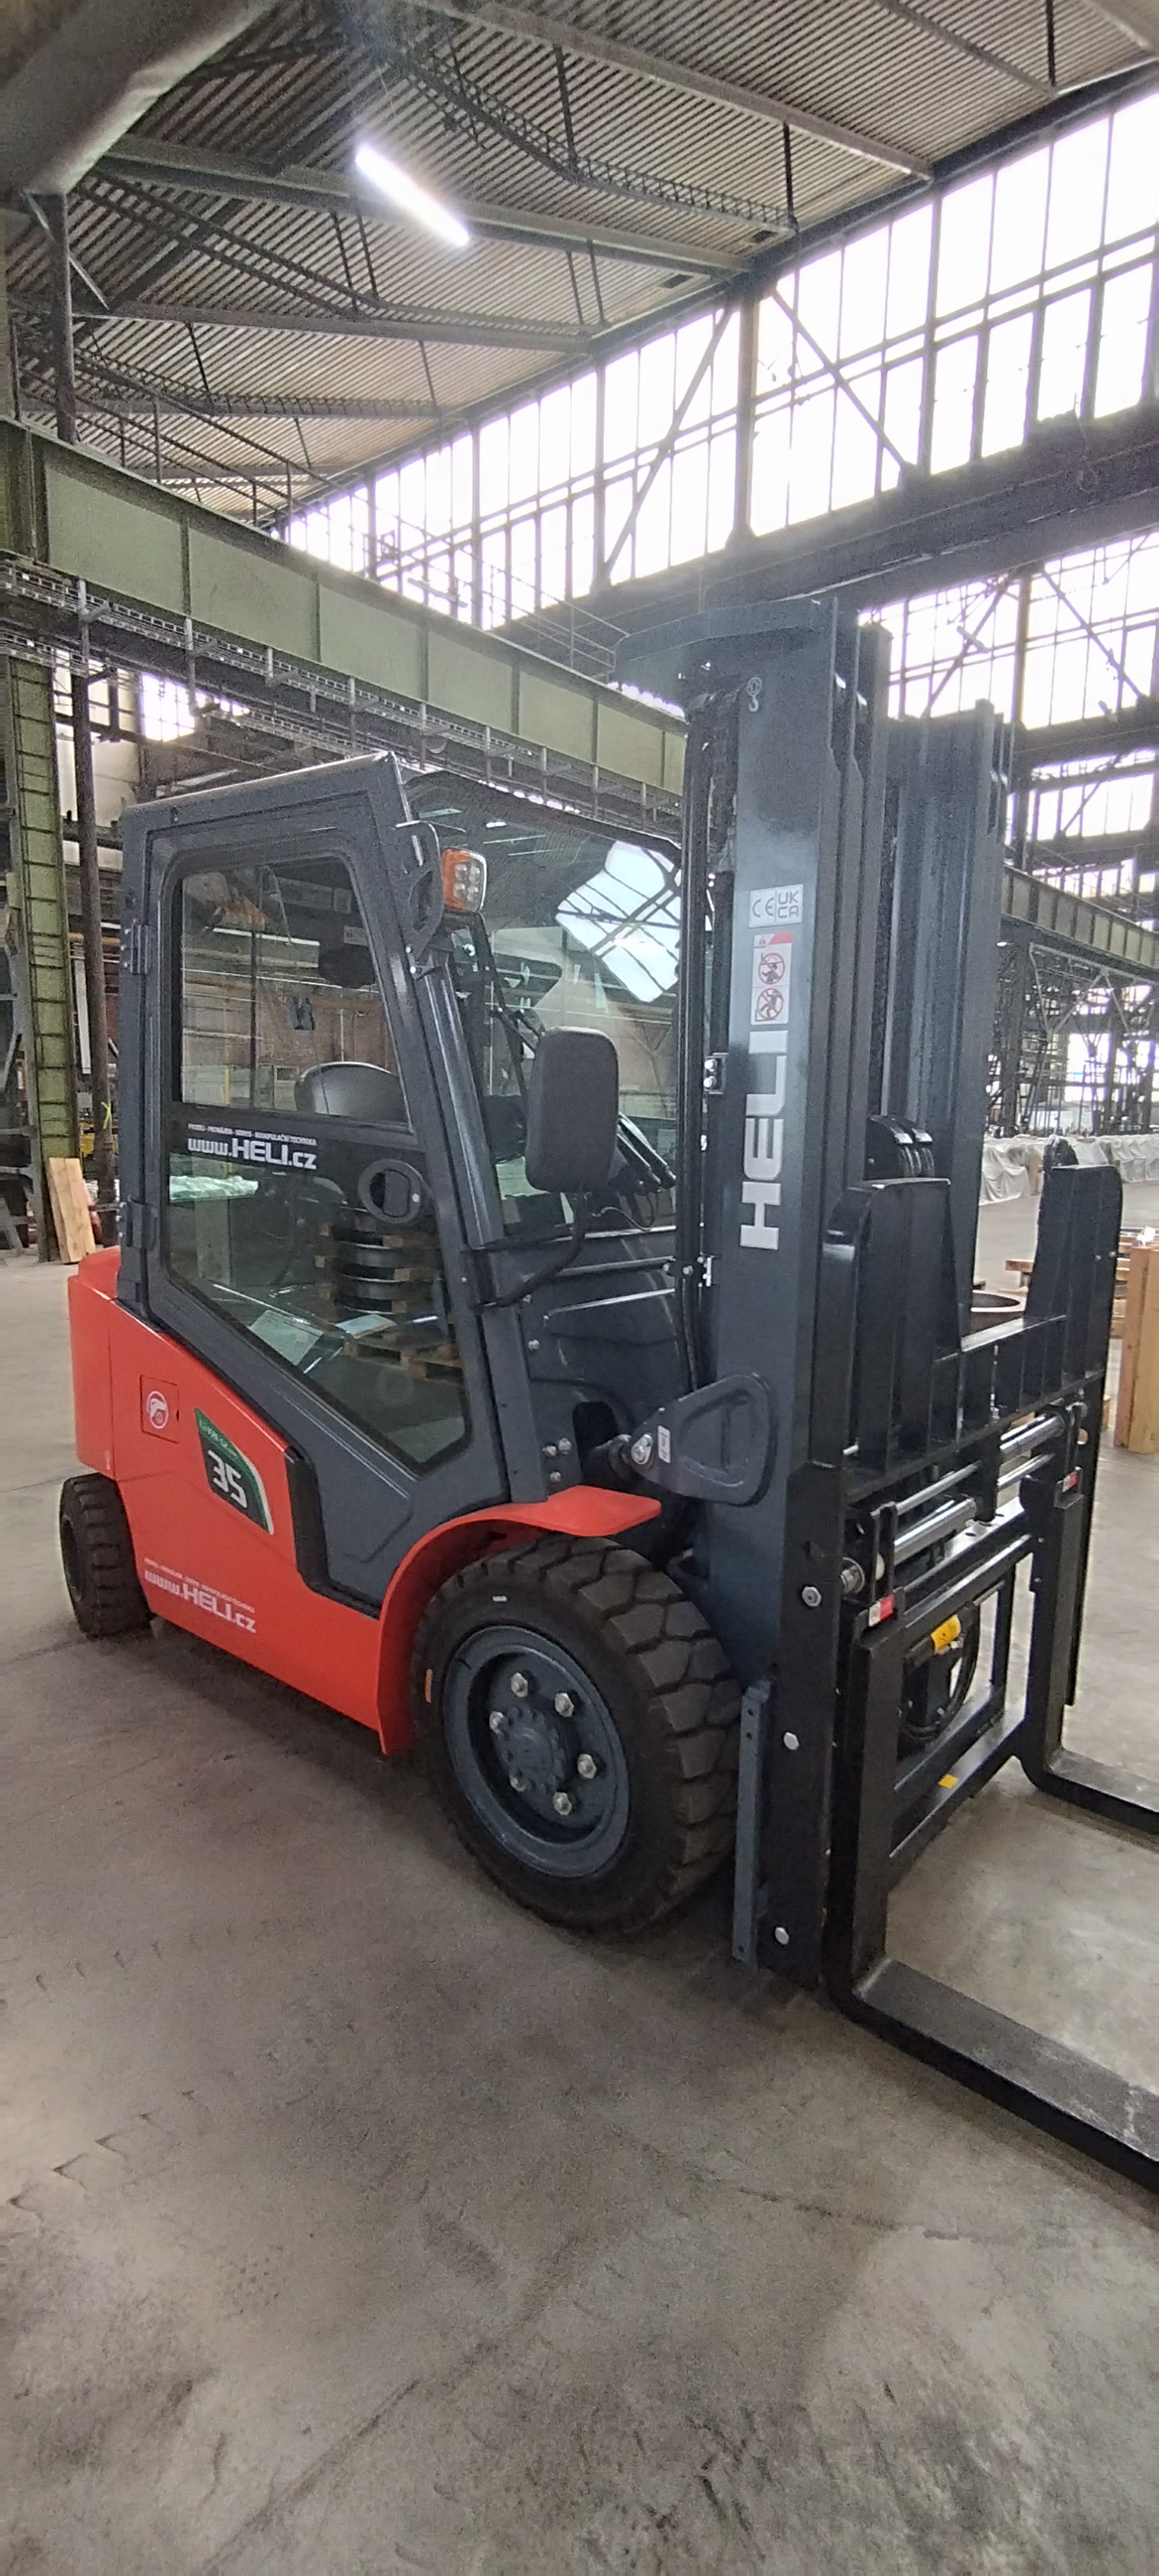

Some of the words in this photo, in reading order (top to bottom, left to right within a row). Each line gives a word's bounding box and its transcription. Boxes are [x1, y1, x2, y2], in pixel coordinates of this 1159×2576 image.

[752, 897, 775, 918] CE
[778, 891, 800, 904] UK
[778, 904, 799, 919] CA
[188, 1137, 317, 1170] www.HELI.cz
[740, 1031, 789, 1249] HELI
[208, 1450, 248, 1508] 35
[144, 1570, 257, 1633] www.HELI.cz
